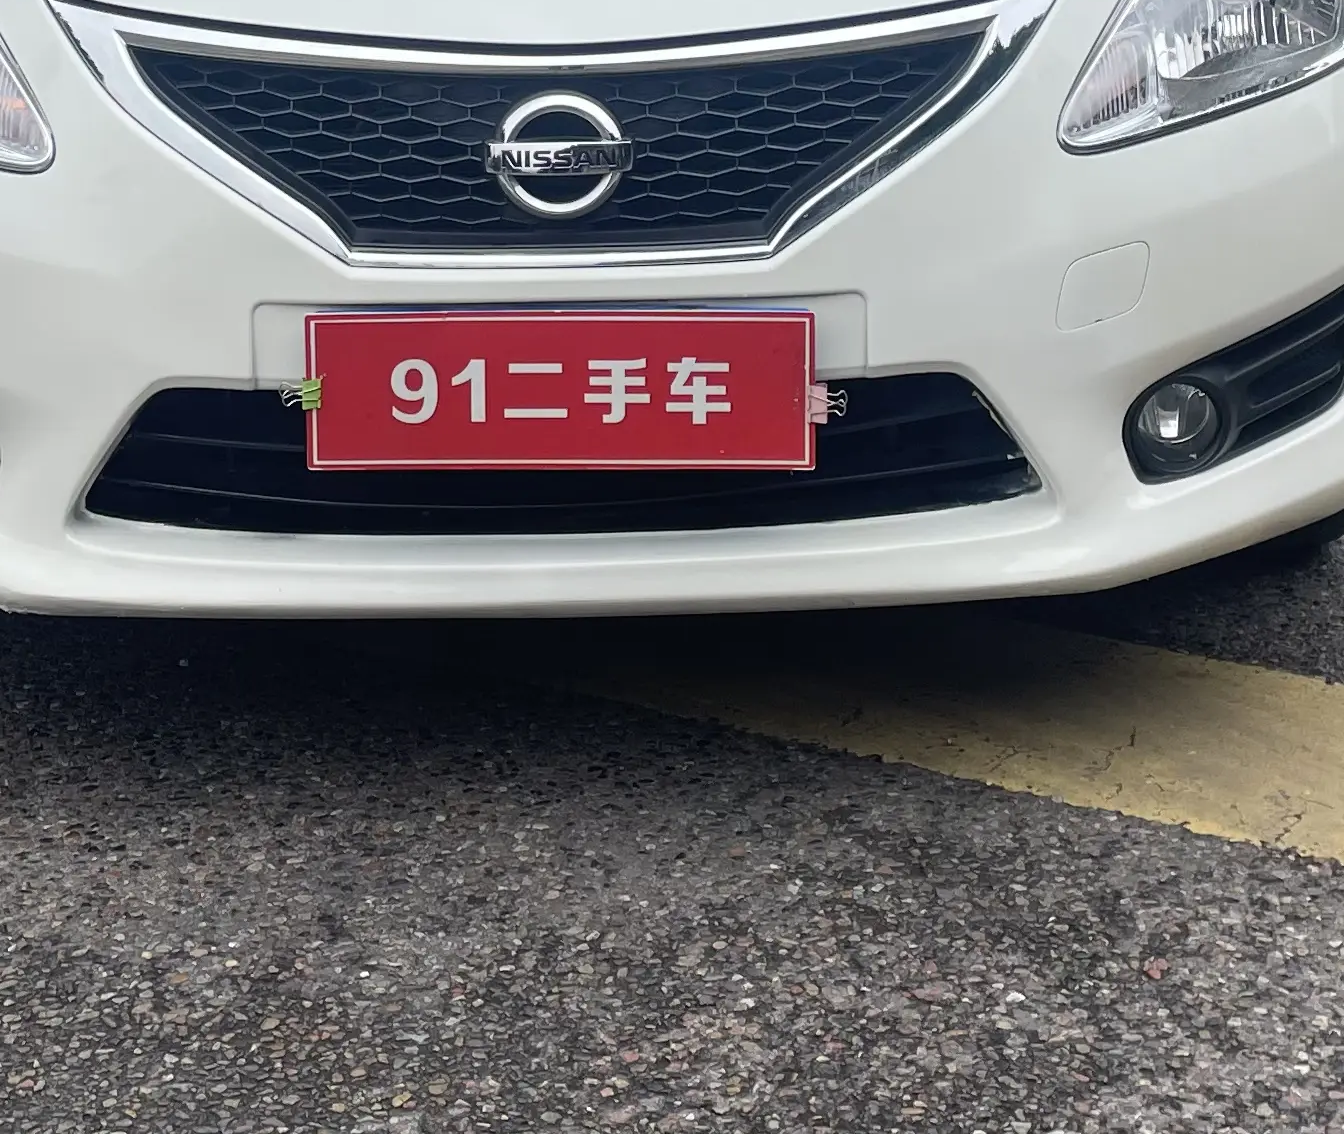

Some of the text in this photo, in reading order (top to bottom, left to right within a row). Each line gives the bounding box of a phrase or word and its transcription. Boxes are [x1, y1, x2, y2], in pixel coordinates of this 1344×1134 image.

[501, 150, 617, 168] NISSAN
[390, 357, 731, 425] 91二手车
